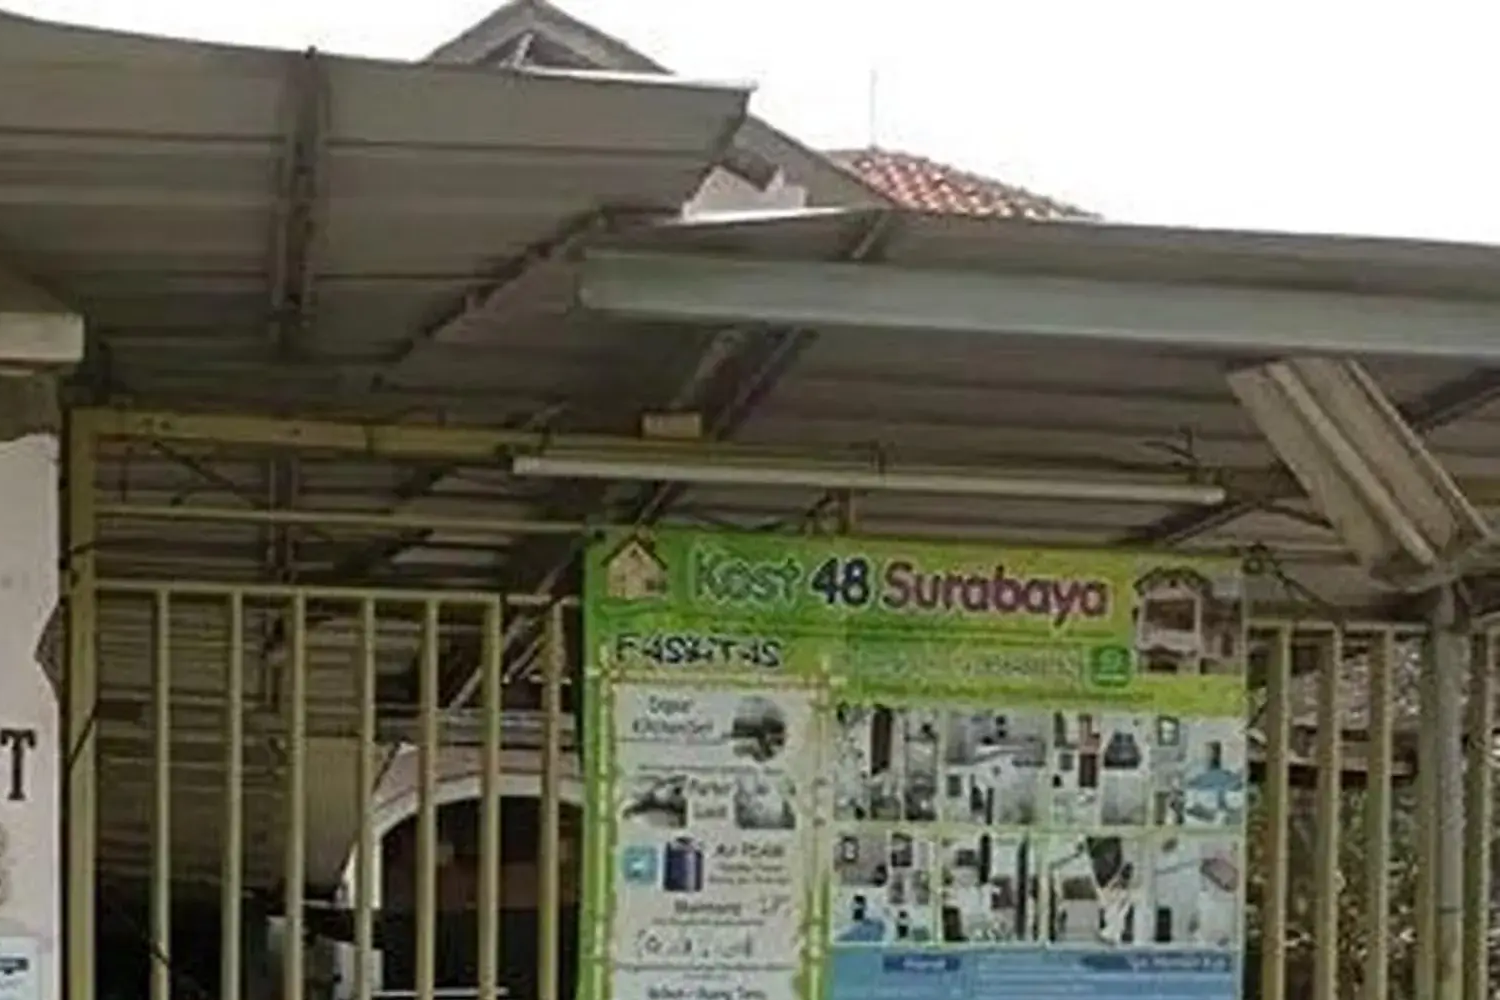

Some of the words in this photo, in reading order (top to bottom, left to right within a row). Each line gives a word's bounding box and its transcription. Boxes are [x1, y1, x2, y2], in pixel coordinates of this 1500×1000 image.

[691, 545, 800, 606] Kost
[809, 556, 873, 608] 48
[882, 559, 1110, 624] Surabaya
